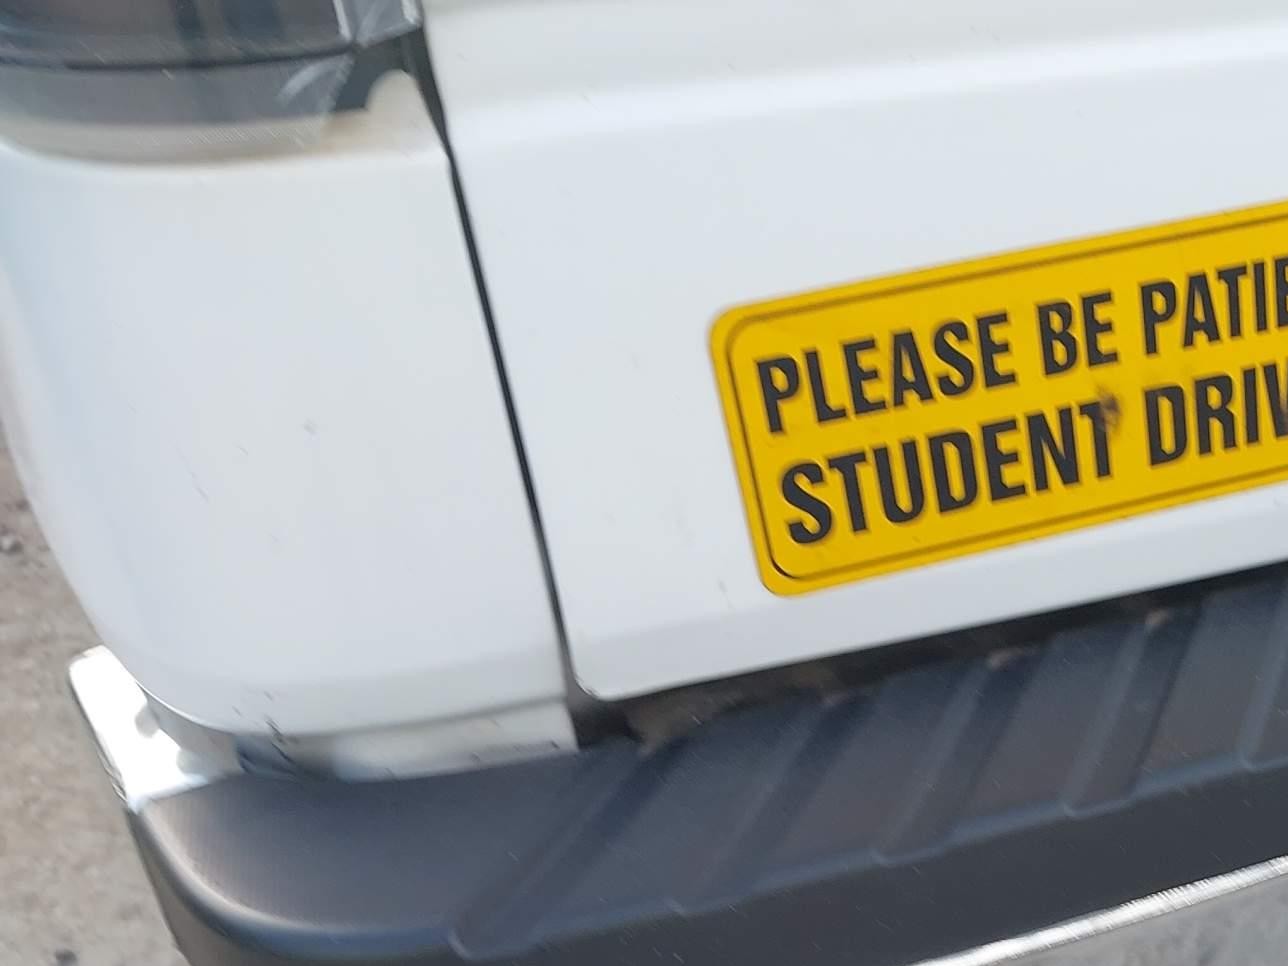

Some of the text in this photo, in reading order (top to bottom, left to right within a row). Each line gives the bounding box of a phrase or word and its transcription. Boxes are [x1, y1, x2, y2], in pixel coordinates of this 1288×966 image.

[754, 309, 1017, 435] PLEASE
[1036, 290, 1121, 378] BE
[779, 400, 1115, 546] STUDENT
